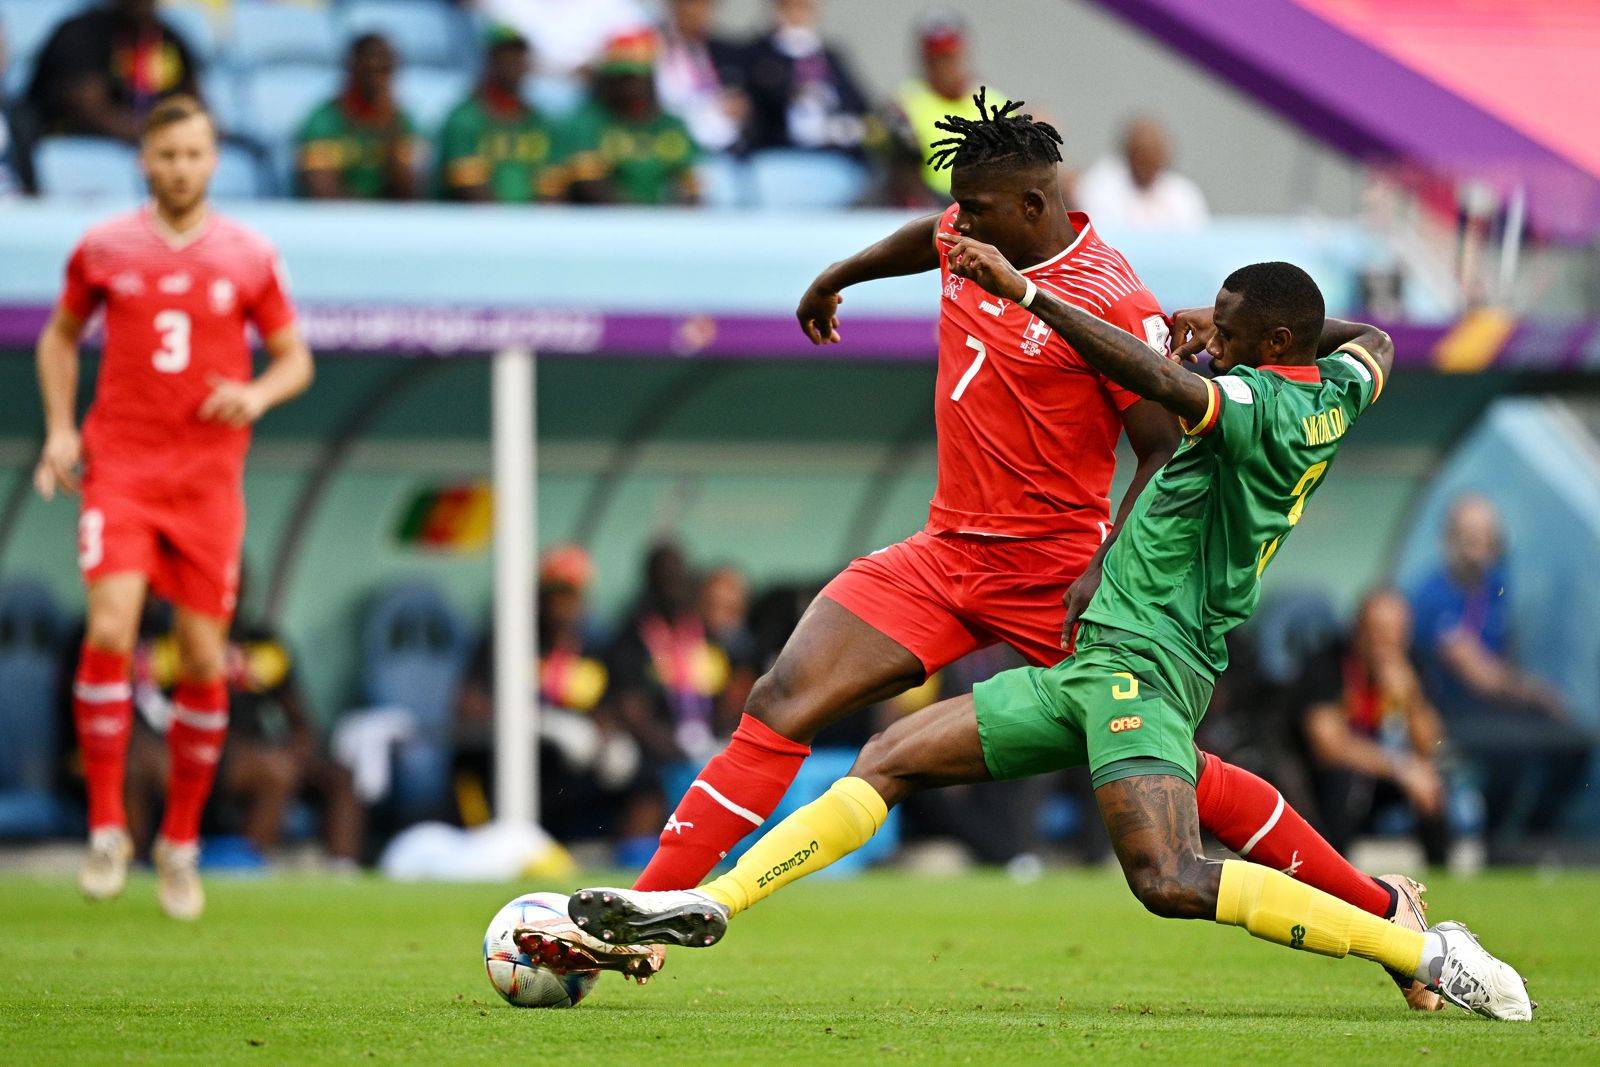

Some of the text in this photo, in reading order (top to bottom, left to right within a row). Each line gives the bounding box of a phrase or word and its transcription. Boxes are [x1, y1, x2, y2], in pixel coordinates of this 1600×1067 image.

[152, 309, 191, 373] 3
[951, 335, 987, 402] 7
[1110, 716, 1141, 732] one
[756, 840, 819, 889] CAMEROUN
